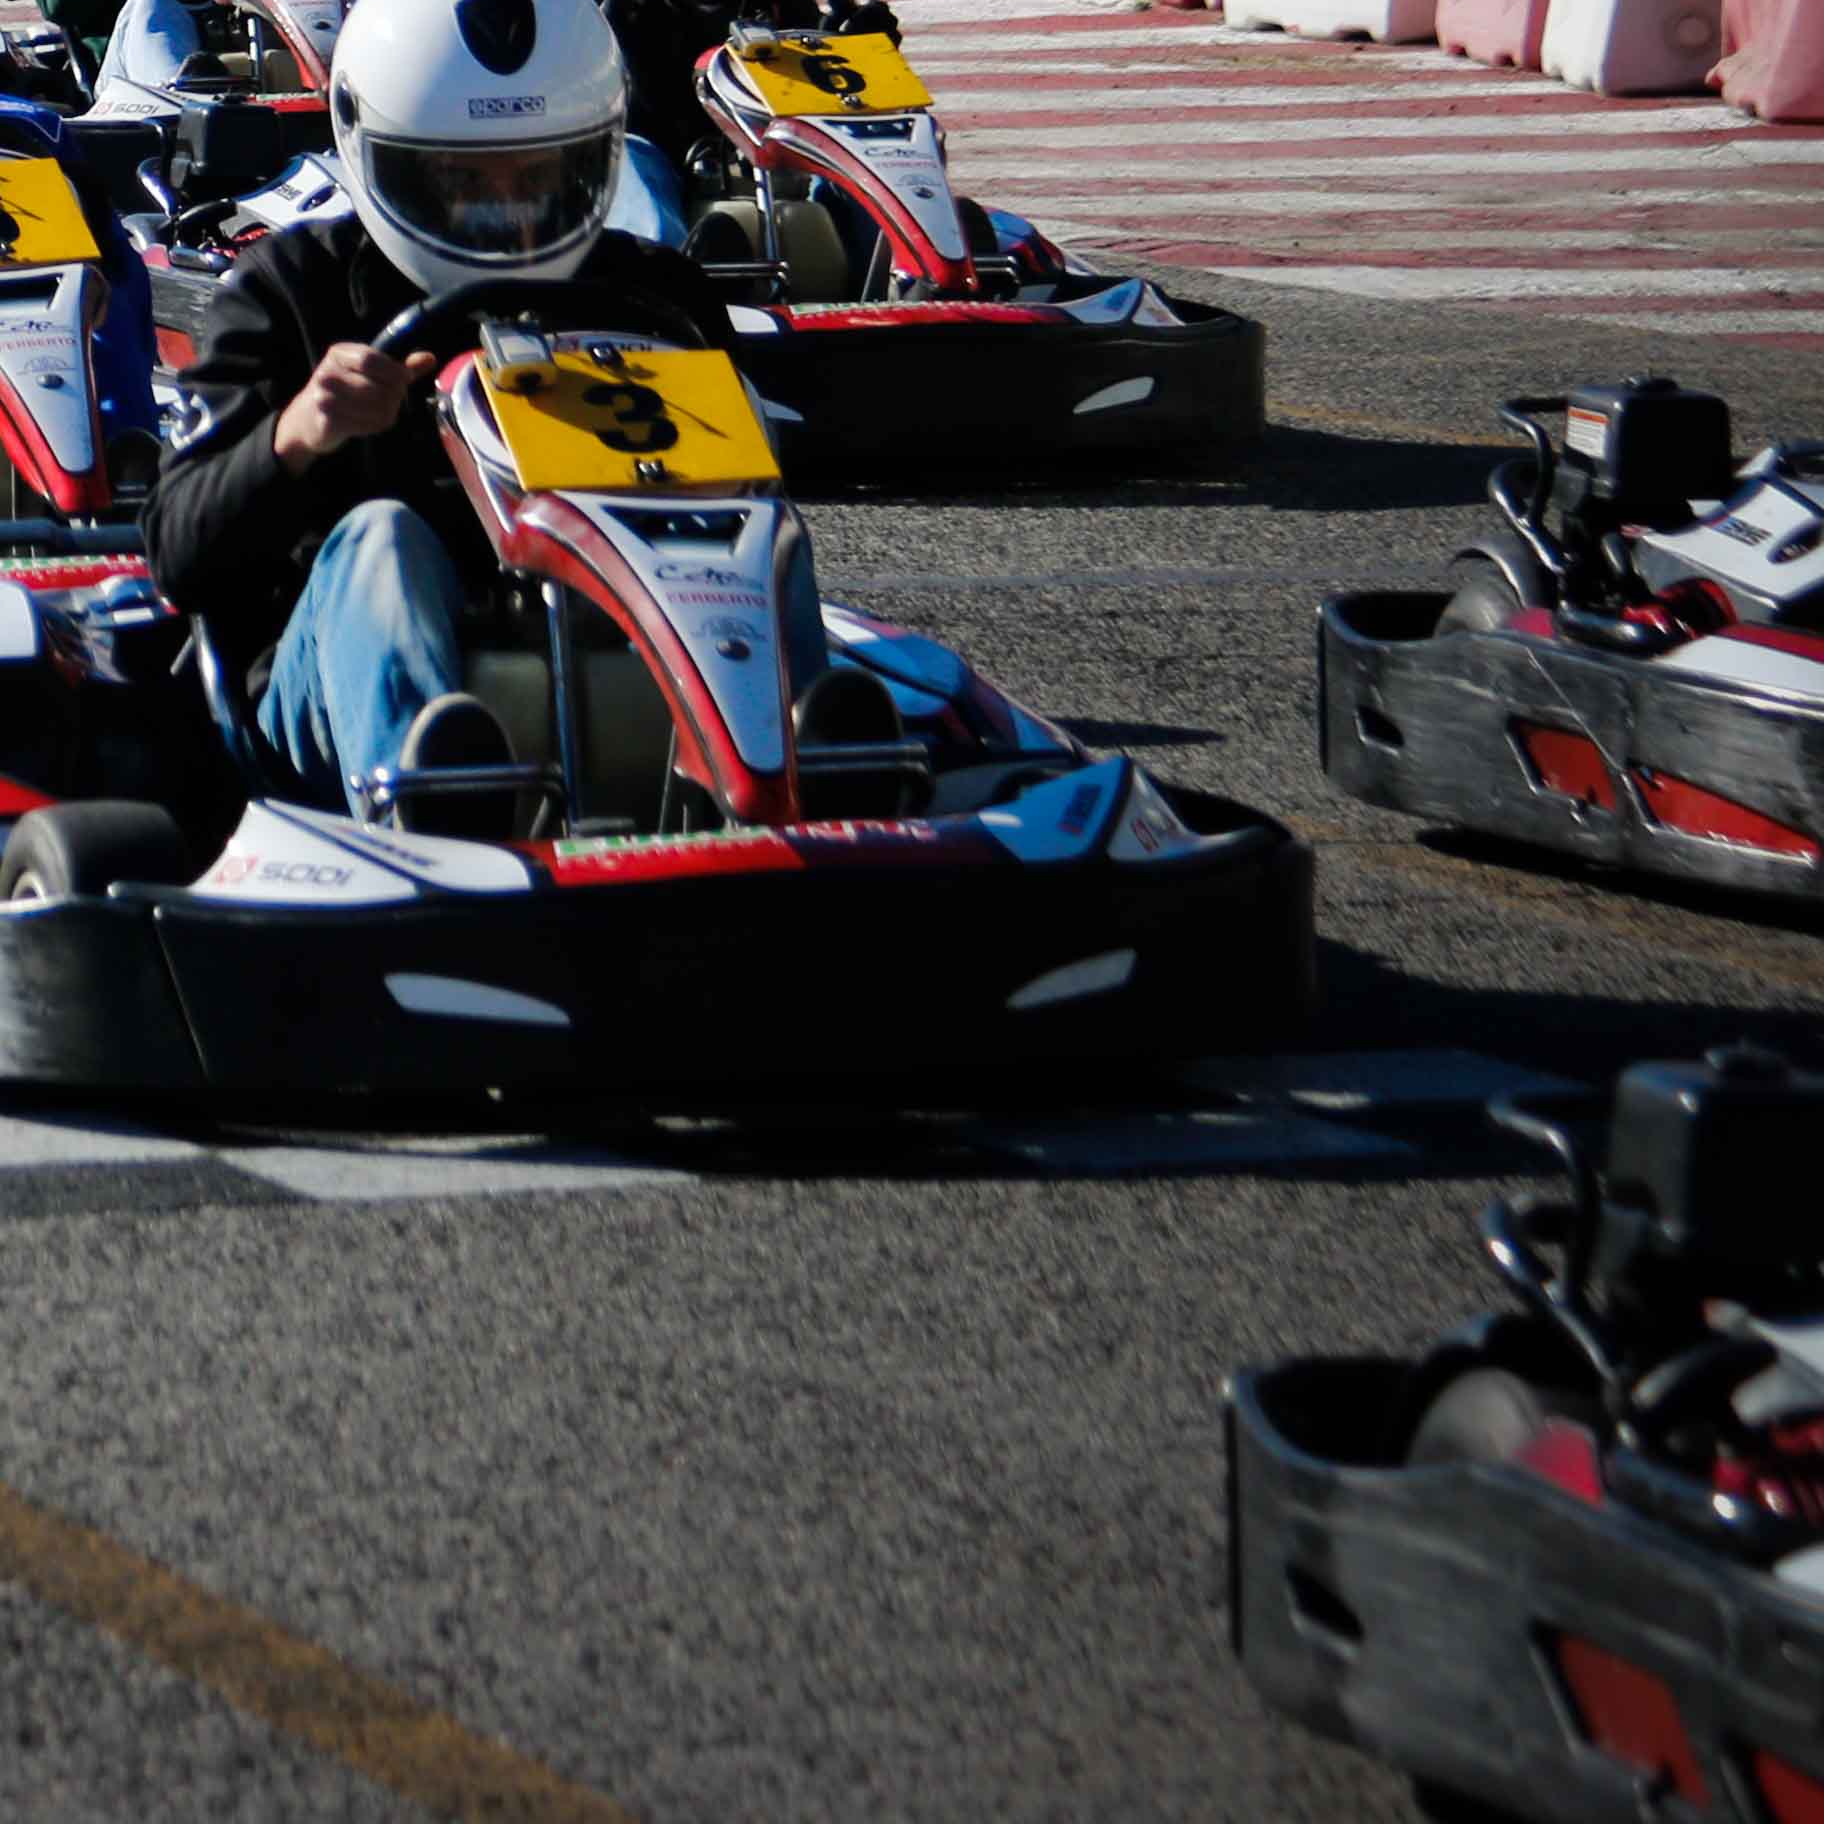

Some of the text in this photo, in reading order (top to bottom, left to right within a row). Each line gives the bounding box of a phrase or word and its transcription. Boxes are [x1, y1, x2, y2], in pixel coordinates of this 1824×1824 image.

[801, 55, 867, 96] 6
[469, 95, 545, 116] sparco
[584, 384, 681, 453] 3
[258, 860, 354, 889] SODI
